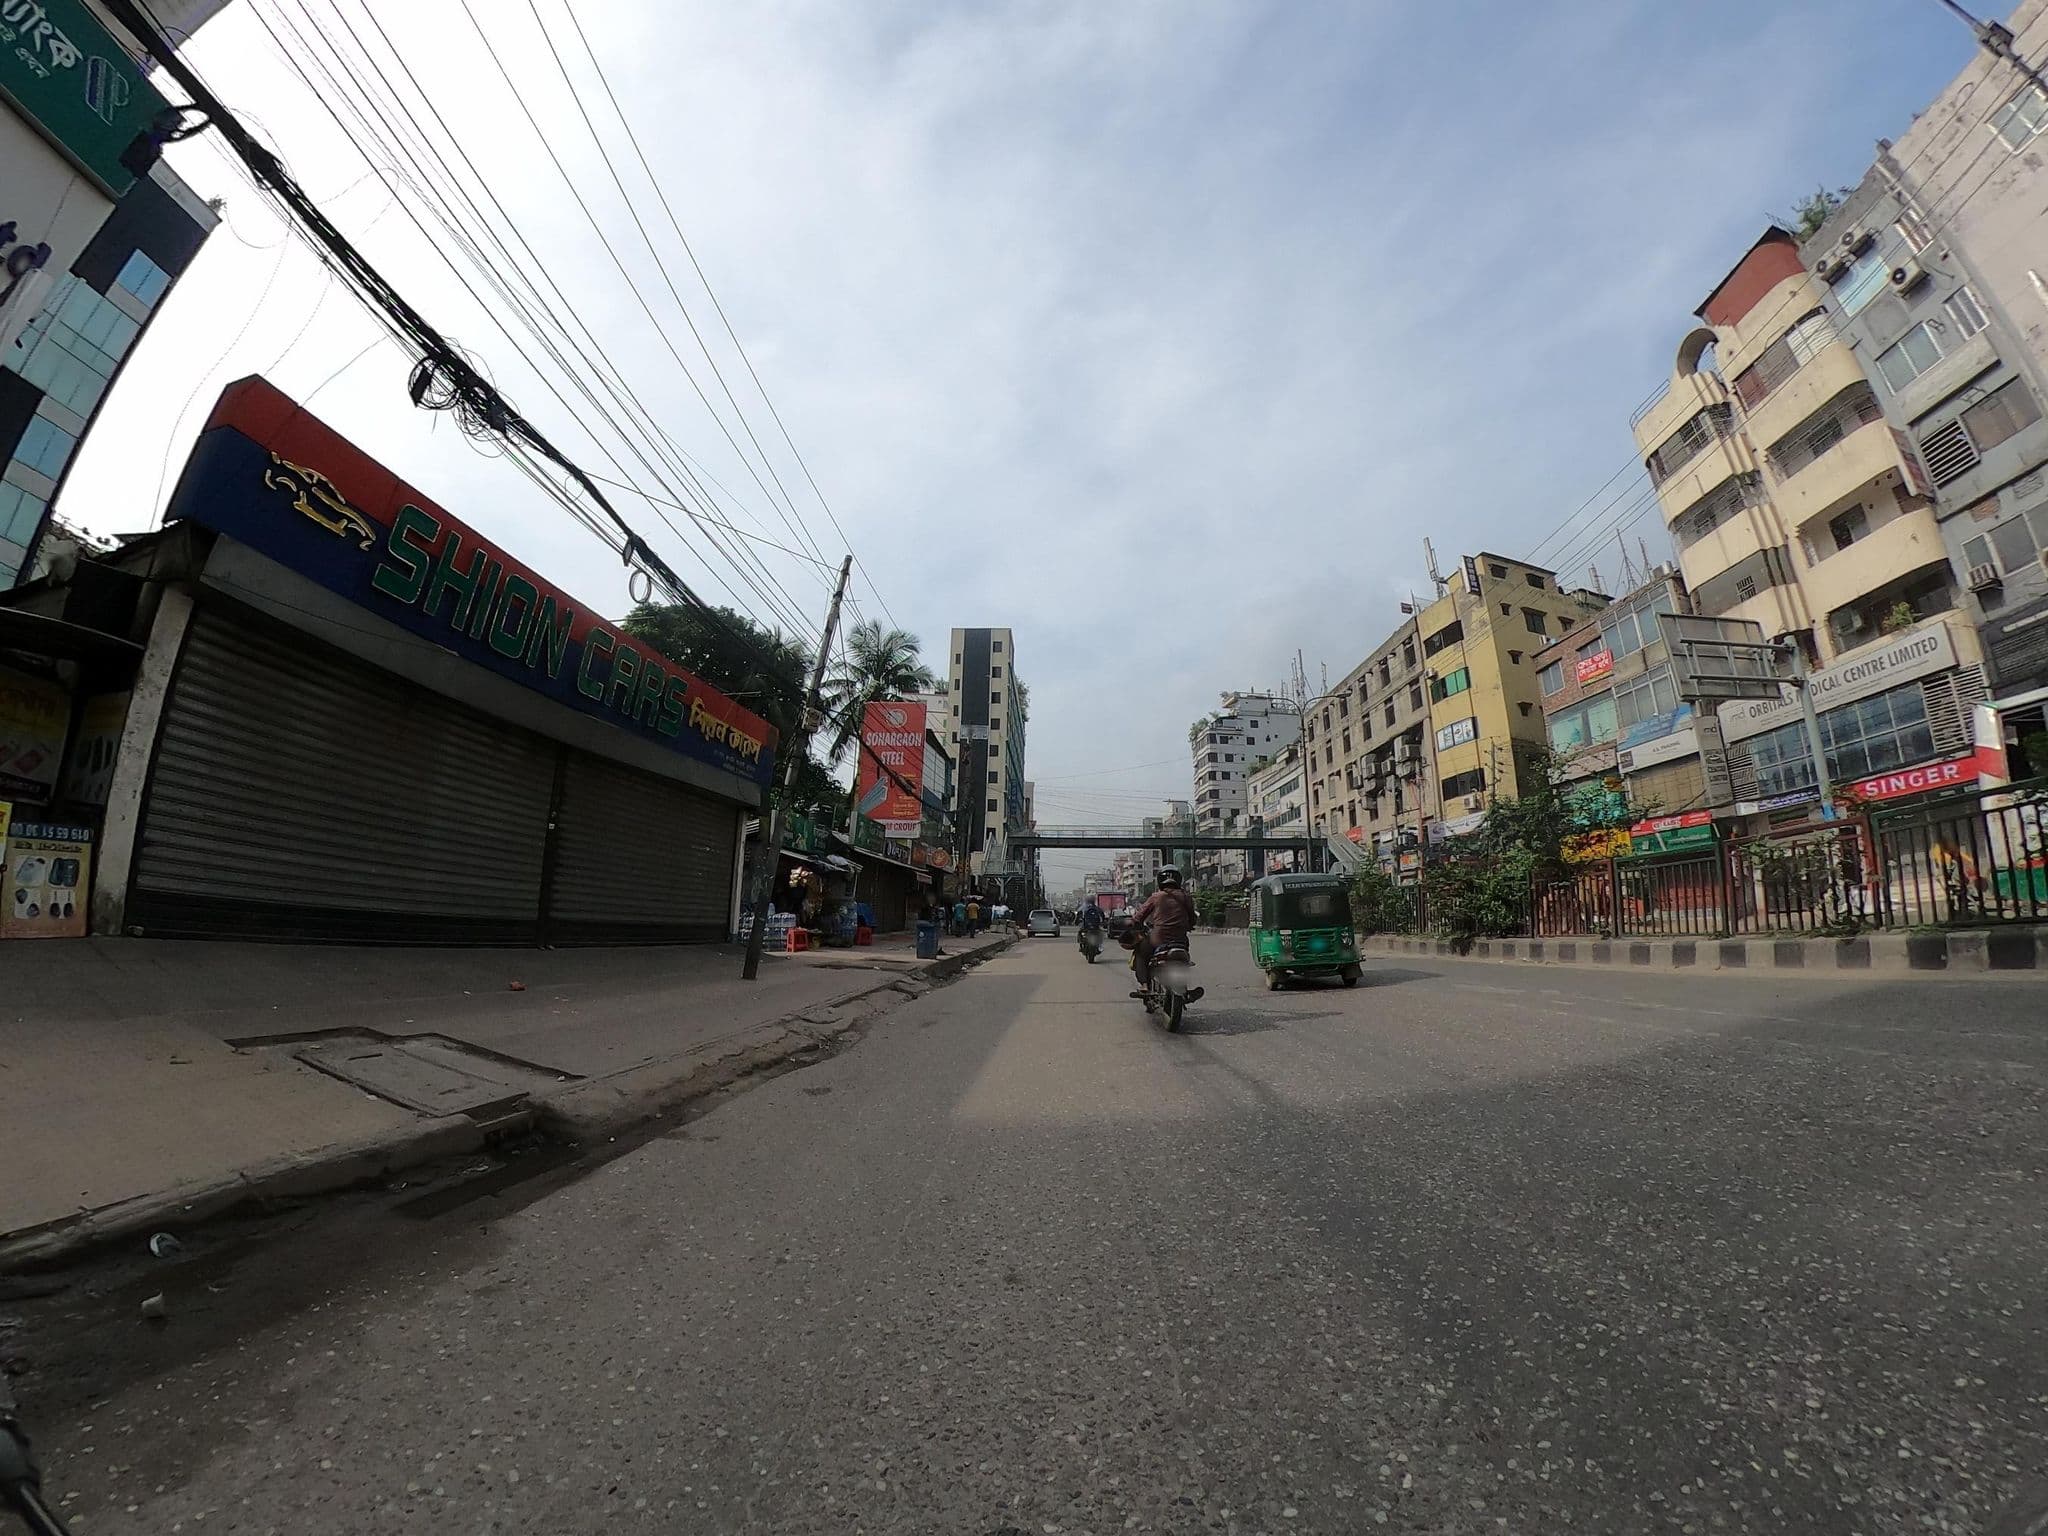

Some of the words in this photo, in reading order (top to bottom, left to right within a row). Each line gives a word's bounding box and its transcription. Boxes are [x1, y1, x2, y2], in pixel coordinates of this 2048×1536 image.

[372, 504, 574, 679] SHION
[576, 627, 688, 738] CARS
[1749, 692, 1794, 718] ORBITALS
[1843, 656, 1886, 683] CENTRE
[1888, 636, 1938, 667] LIMITED
[866, 732, 922, 746] SONARGAON
[881, 751, 905, 765] STEEL
[1865, 764, 1961, 797] SINGER
